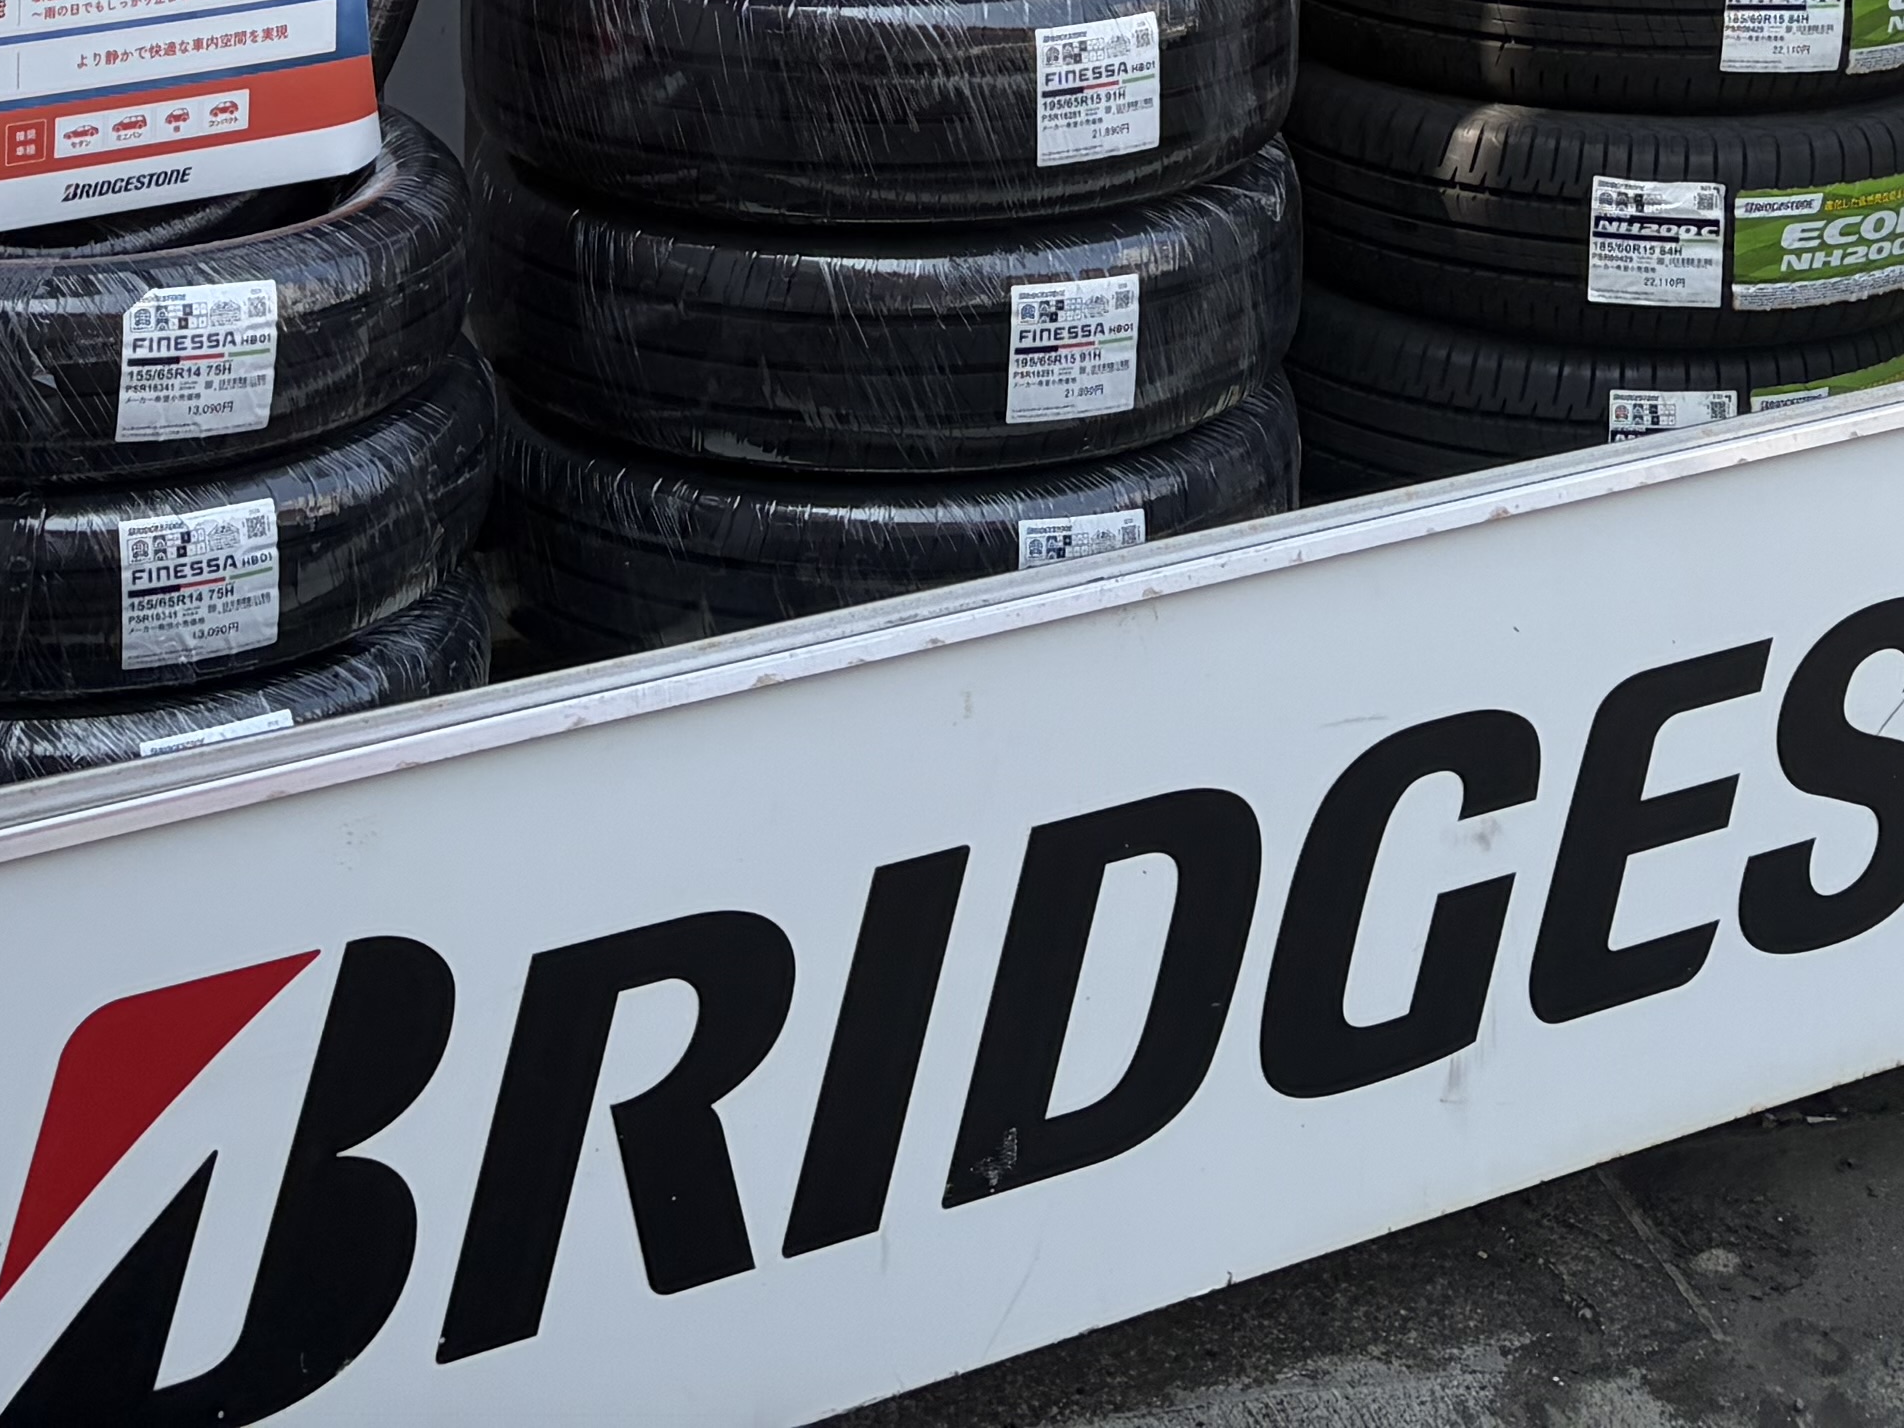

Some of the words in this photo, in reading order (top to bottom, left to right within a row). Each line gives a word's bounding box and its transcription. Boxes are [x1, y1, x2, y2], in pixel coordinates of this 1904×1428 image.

[76, 24, 289, 69] より静かで快適な車内空間を実現
[1046, 62, 1128, 86] FINESSA
[1043, 94, 1102, 111] 195/65R15
[1105, 90, 1126, 103] 91H
[61, 166, 193, 203] BRIDGESTONE
[132, 331, 237, 354] FINESSA
[241, 333, 271, 345] HB01
[1019, 323, 1105, 343] FINESSA
[128, 366, 201, 382] 155/65R14
[206, 364, 232, 376] 75H
[188, 401, 234, 416] 13,090円
[131, 554, 237, 586] FINESSA
[129, 593, 203, 612] 155/65R14
[208, 586, 234, 601] 75H
